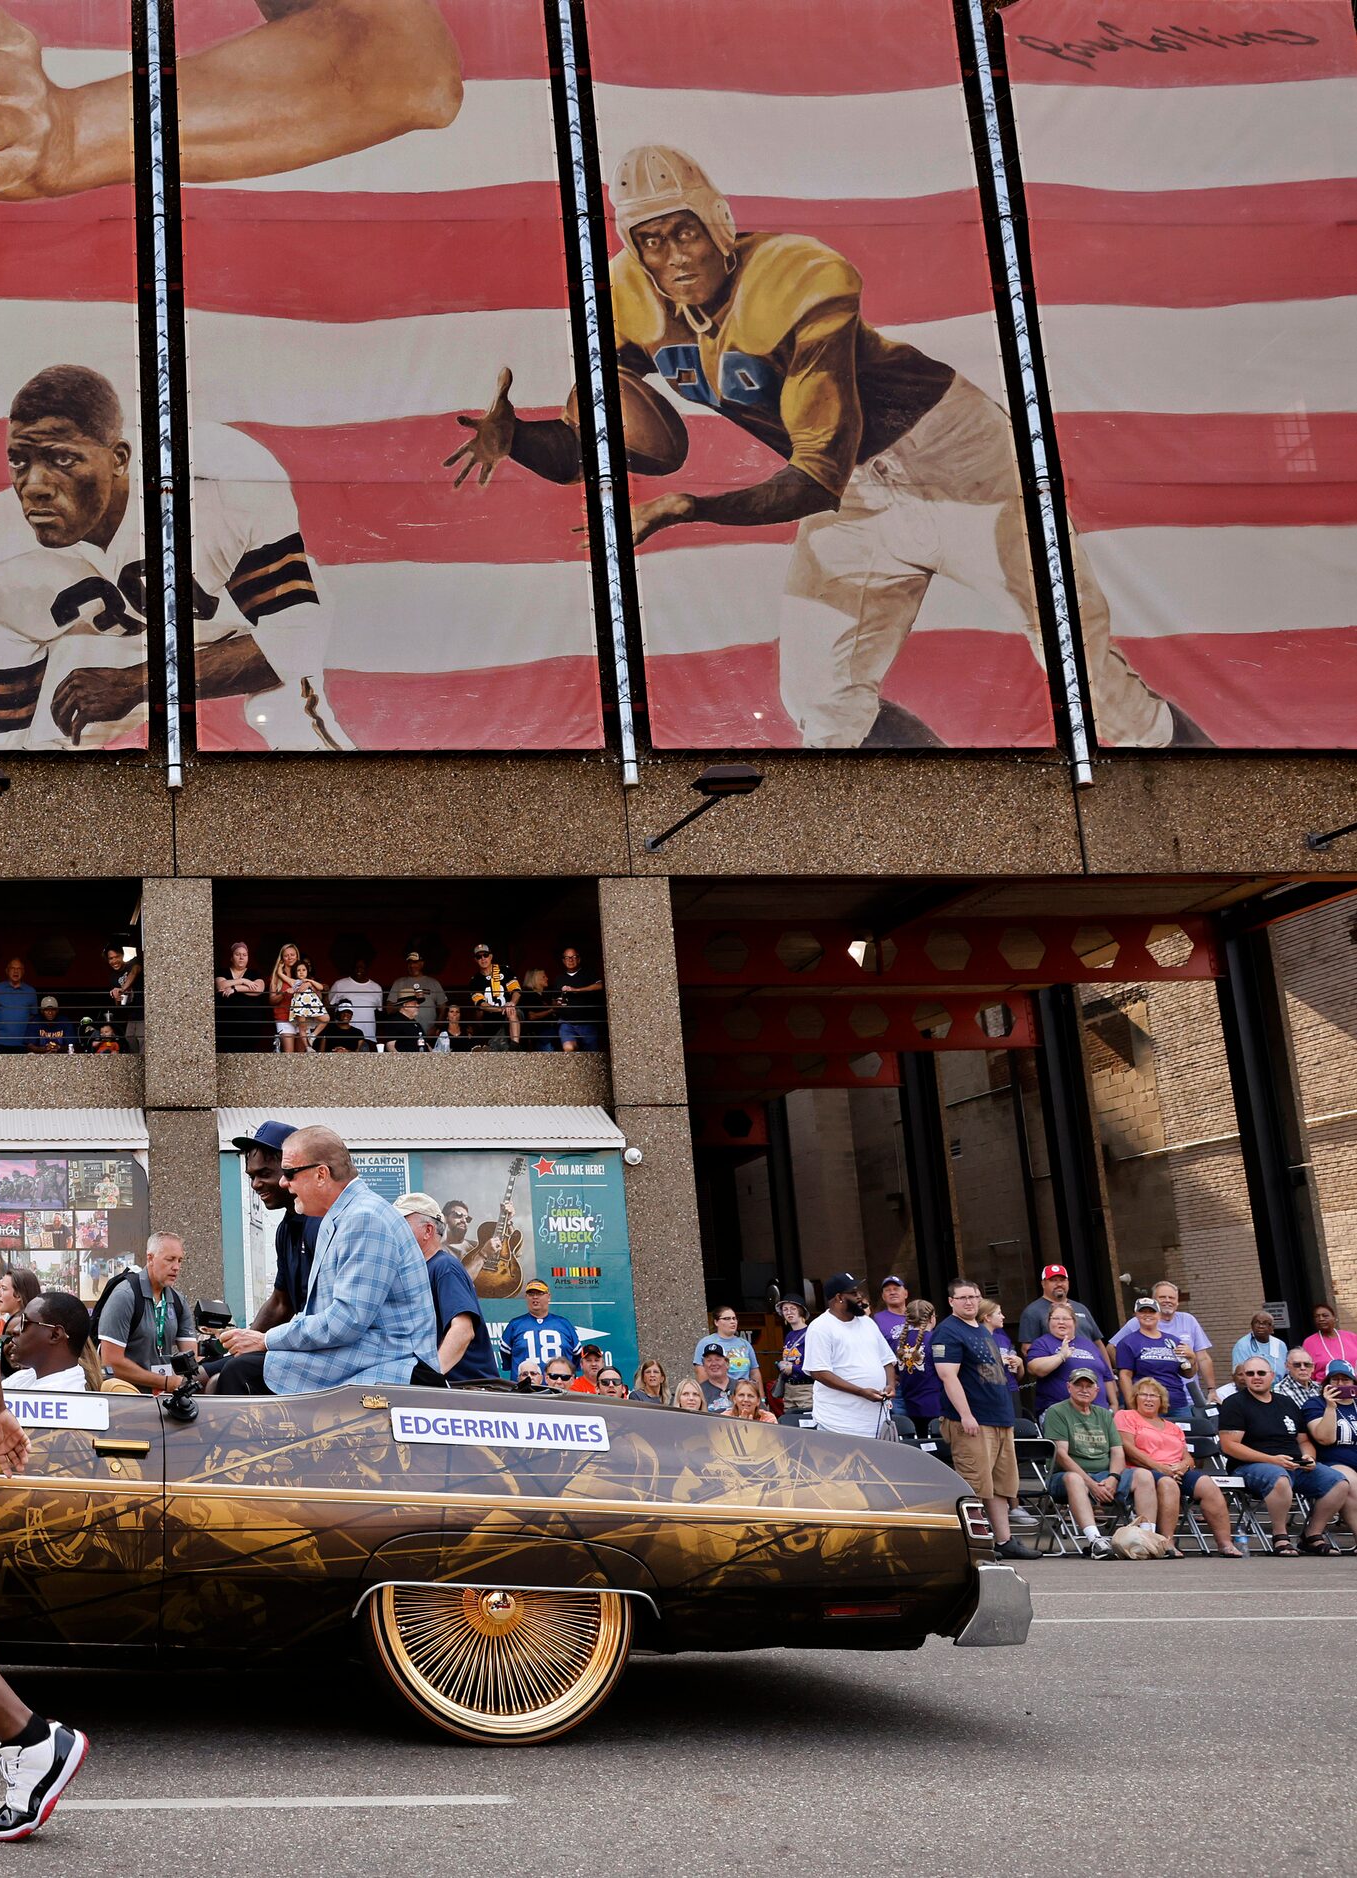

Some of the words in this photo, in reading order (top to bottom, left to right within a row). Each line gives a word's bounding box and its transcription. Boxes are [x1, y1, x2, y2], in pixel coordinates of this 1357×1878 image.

[368, 1157, 404, 1165] CANTON
[555, 1164, 569, 1175] YOU
[570, 1164, 584, 1175] ARE
[585, 1164, 605, 1175] HERE!
[551, 1208, 583, 1217] CANTON
[549, 1217, 595, 1232] MUSIC
[558, 1231, 593, 1242] BLOCK
[523, 1329, 562, 1365] 18
[399, 1415, 519, 1439] EDGERRIN
[525, 1422, 603, 1443] JAMES
